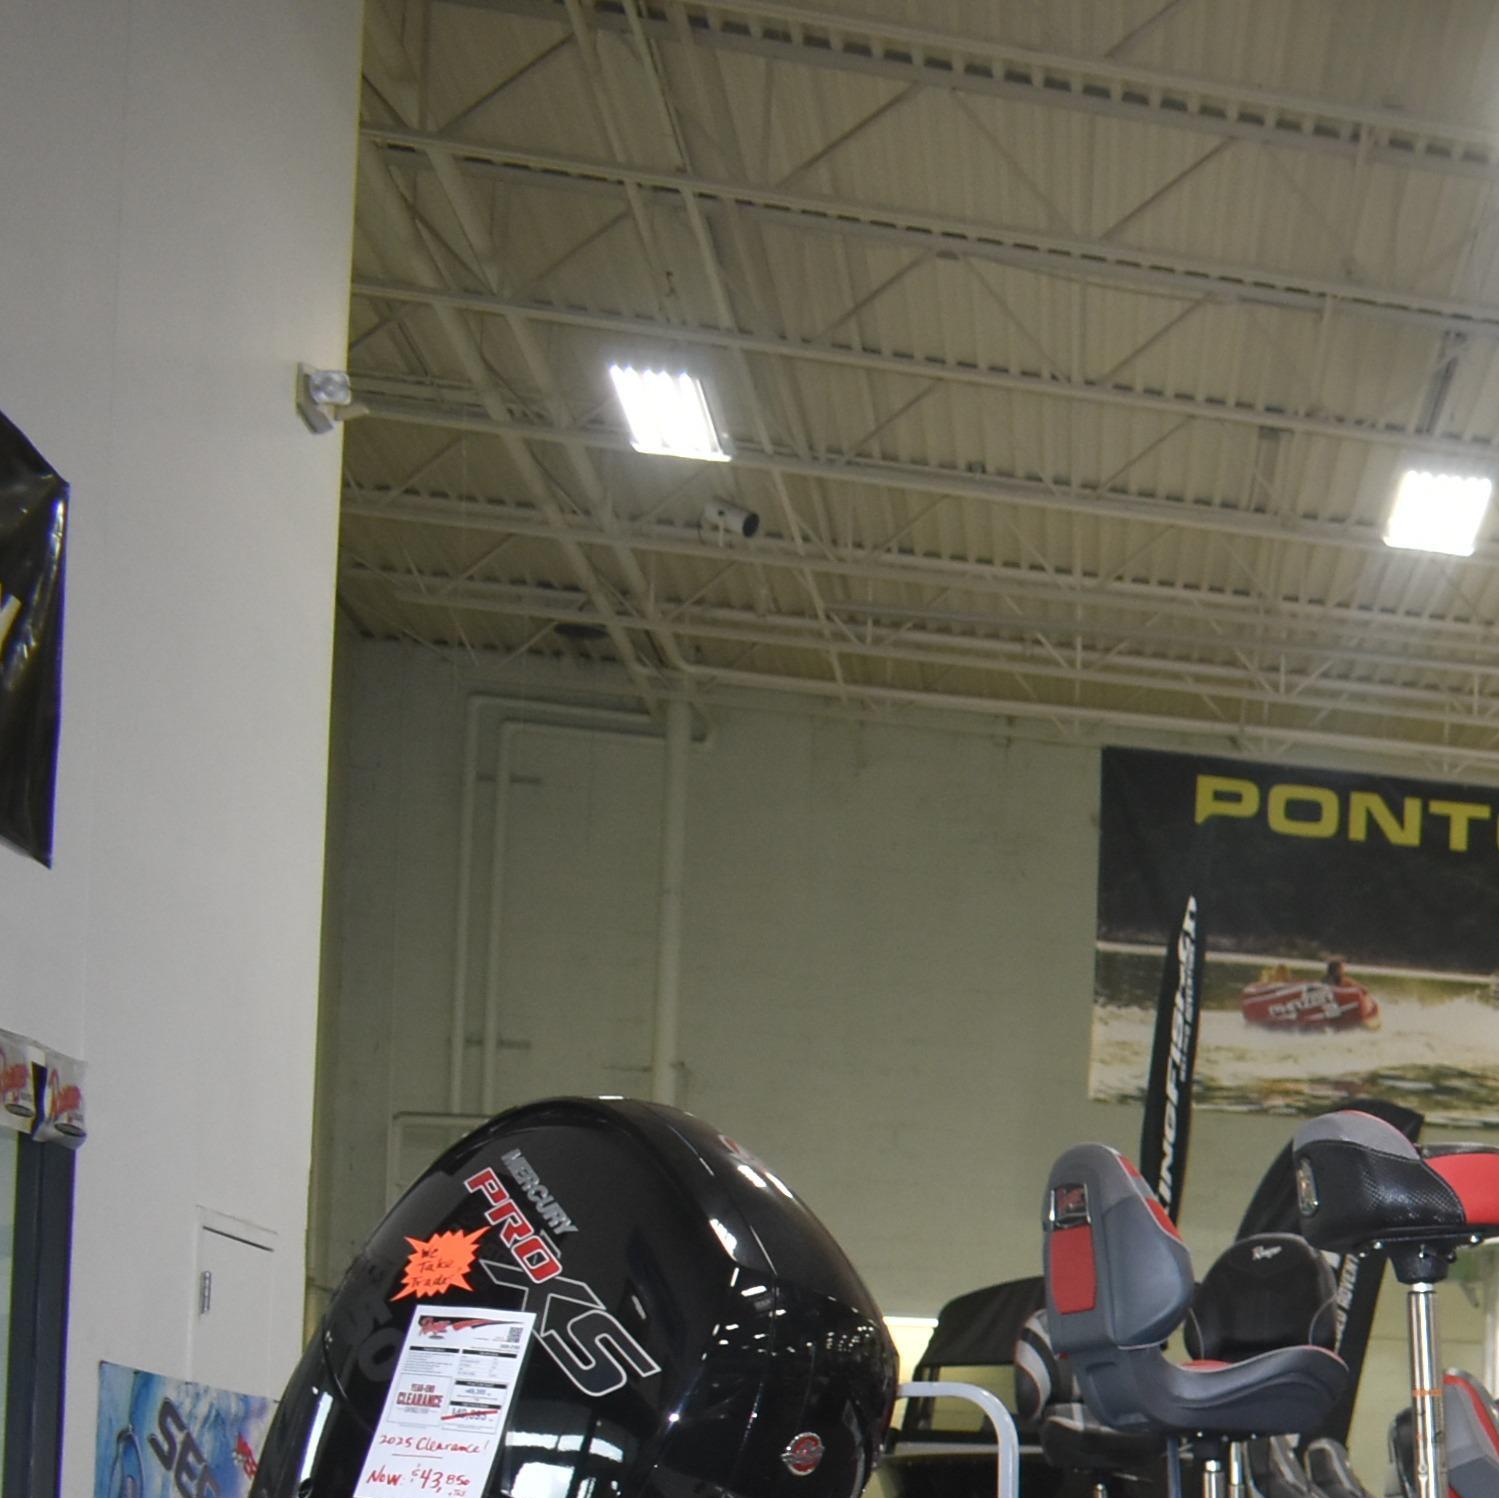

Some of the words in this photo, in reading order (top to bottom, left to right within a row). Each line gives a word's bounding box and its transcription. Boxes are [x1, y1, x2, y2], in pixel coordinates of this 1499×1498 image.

[464, 1167, 562, 1283] PRO
[501, 1148, 579, 1234] MERCURY
[479, 1230, 661, 1396] XS
[379, 1434, 413, 1448] 2025
[396, 1391, 443, 1408] CLEARANCE
